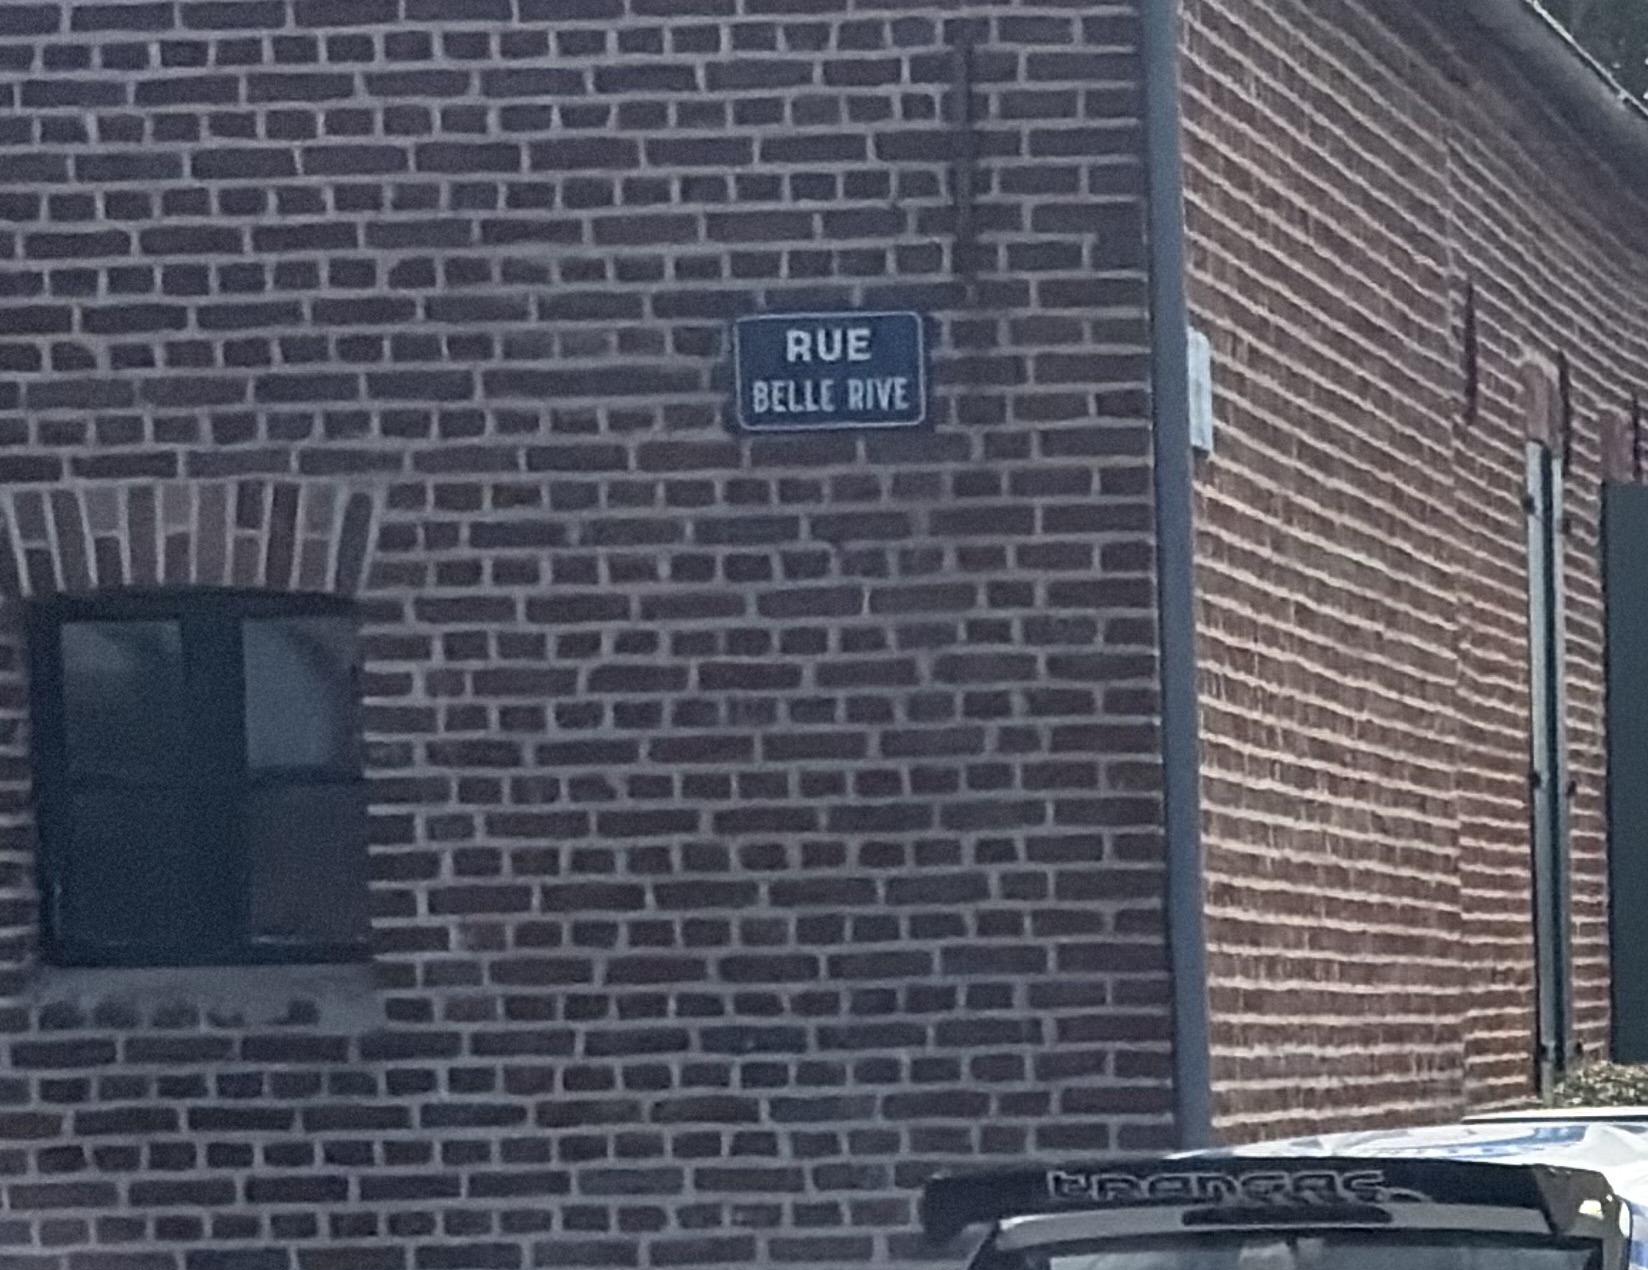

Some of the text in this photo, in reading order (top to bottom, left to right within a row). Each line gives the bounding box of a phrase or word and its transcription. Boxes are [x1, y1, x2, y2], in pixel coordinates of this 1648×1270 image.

[786, 328, 872, 362] RUE
[752, 376, 909, 413] BELLE RIVE
